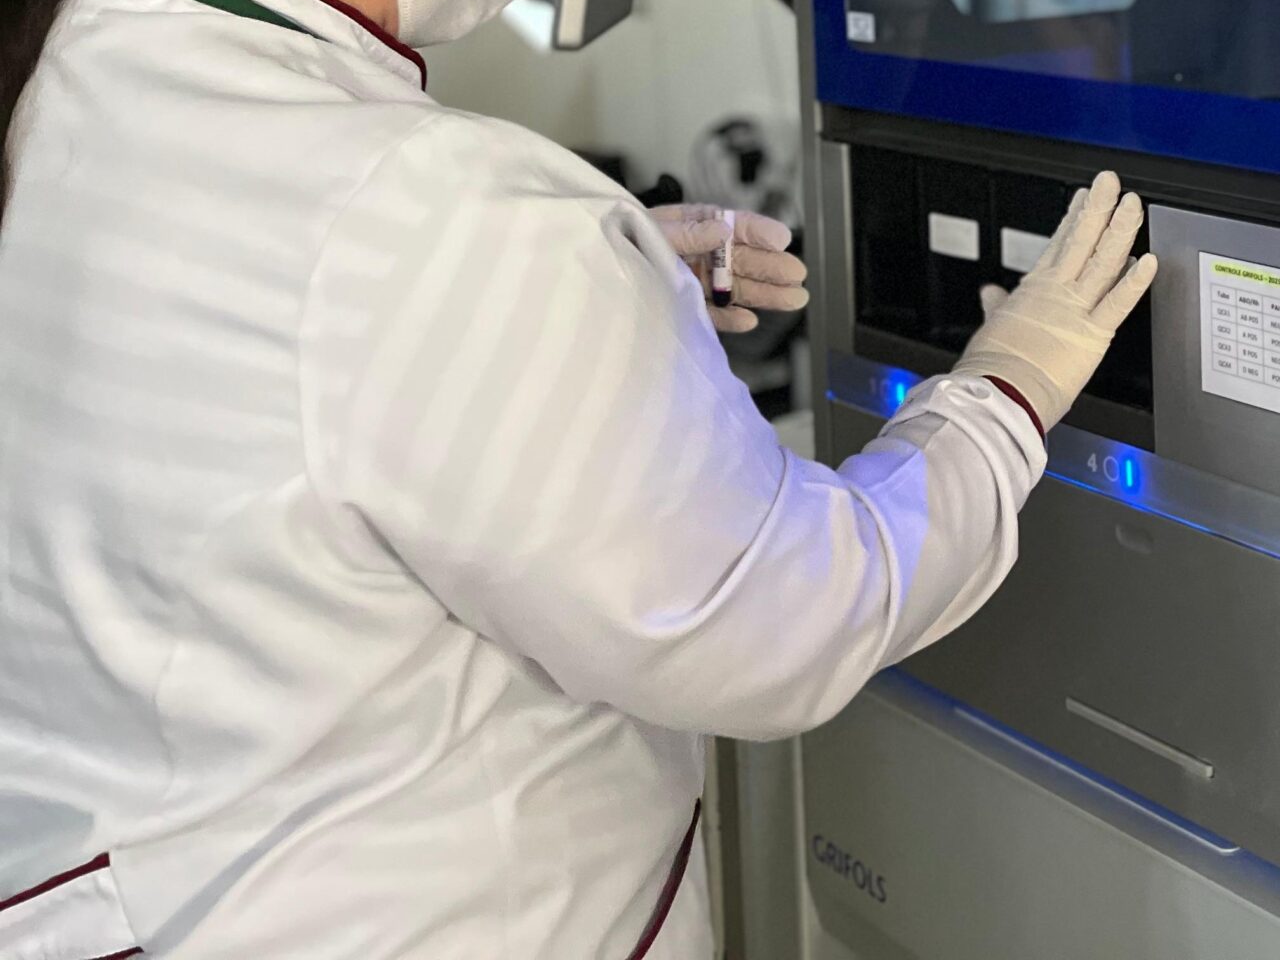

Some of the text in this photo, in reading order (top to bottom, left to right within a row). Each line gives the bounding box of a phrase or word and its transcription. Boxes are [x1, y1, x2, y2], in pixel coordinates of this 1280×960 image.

[1242, 270, 1263, 281] GRIFOLS
[1087, 452, 1098, 473] 4
[811, 834, 887, 903] GRIFOLS
